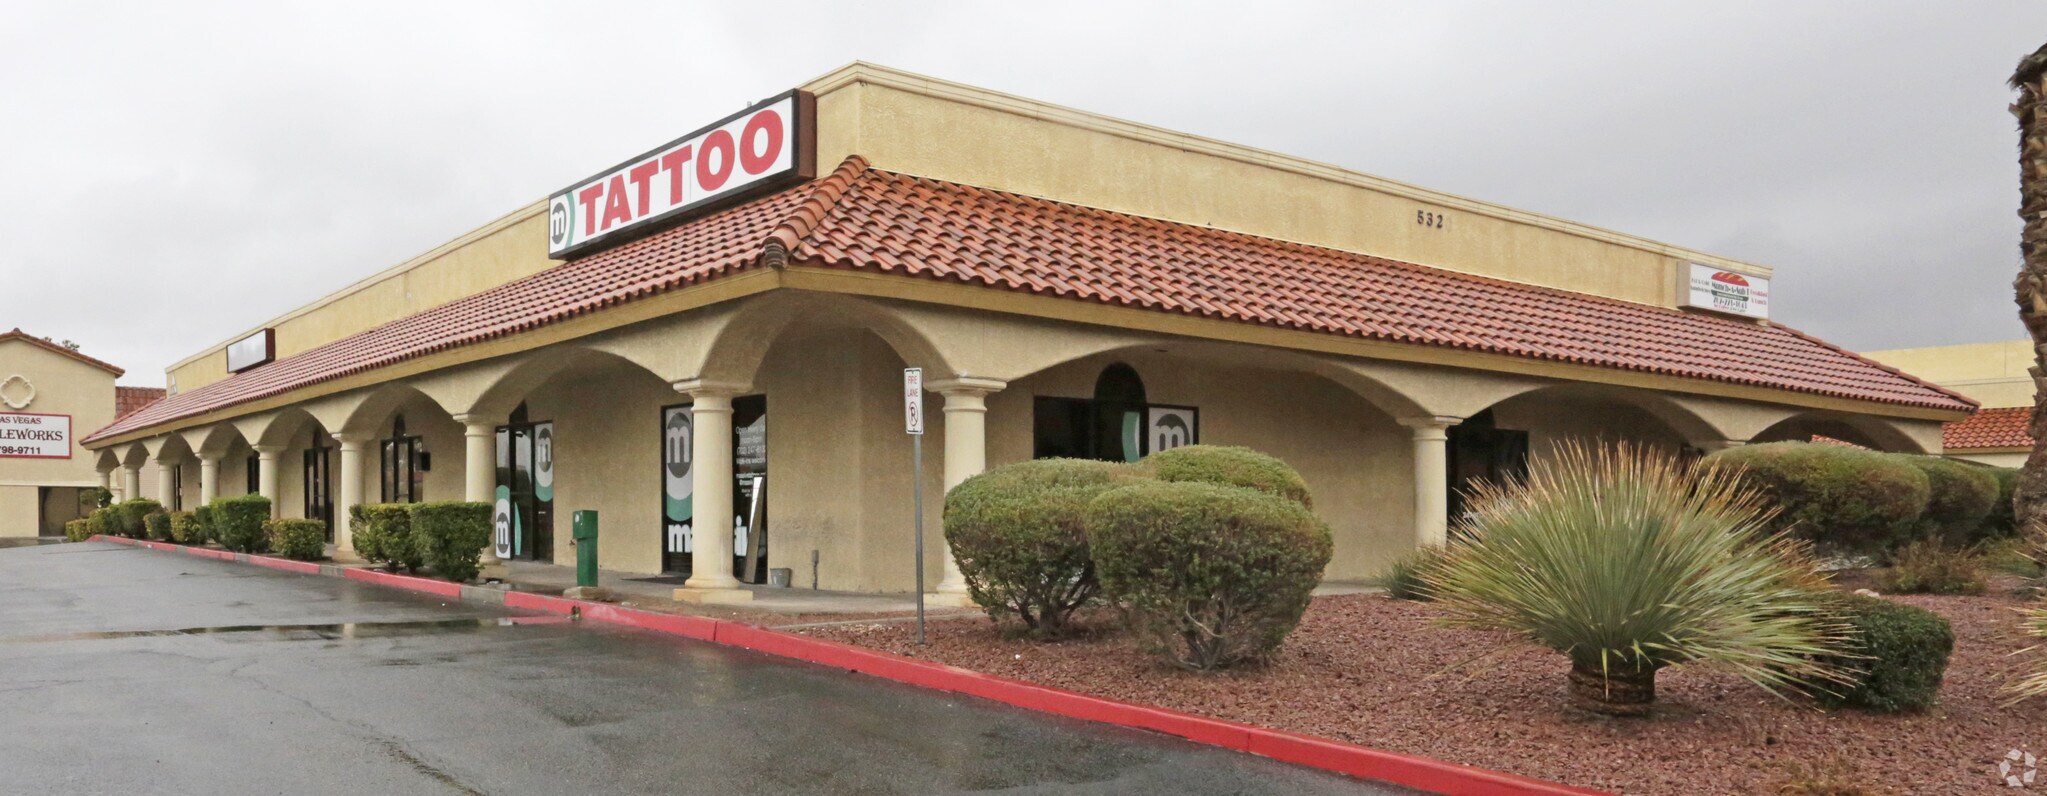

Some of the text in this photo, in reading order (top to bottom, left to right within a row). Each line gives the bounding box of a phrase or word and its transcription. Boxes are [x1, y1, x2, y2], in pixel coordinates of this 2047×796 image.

[579, 109, 784, 236] TATTOO
[1417, 210, 1443, 228] 532
[907, 375, 918, 384] FIRE
[907, 388, 919, 397] LANE
[13, 416, 42, 424] VEGAS
[0, 428, 63, 441] LEWORKS
[0, 446, 41, 455] 98-9711
